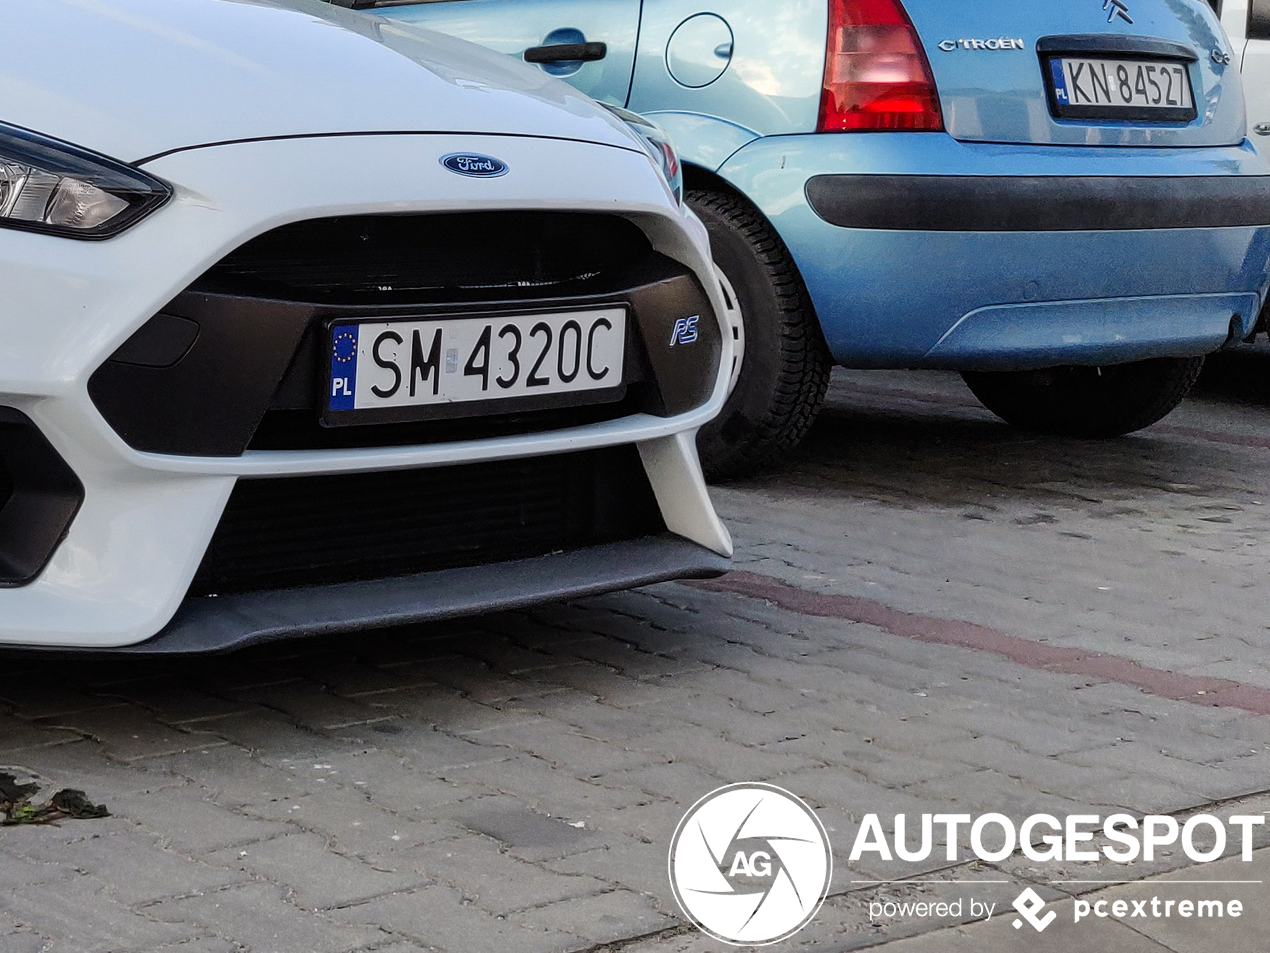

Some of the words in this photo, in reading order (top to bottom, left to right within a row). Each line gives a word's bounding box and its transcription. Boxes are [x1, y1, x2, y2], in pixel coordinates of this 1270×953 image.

[1056, 88, 1067, 100] PL
[1068, 62, 1112, 103] KN
[1116, 64, 1183, 106] 84527
[457, 157, 495, 170] Ford
[669, 315, 699, 346] RS
[371, 328, 442, 398] SM
[463, 317, 613, 391] 4320C
[332, 377, 351, 396] PL
